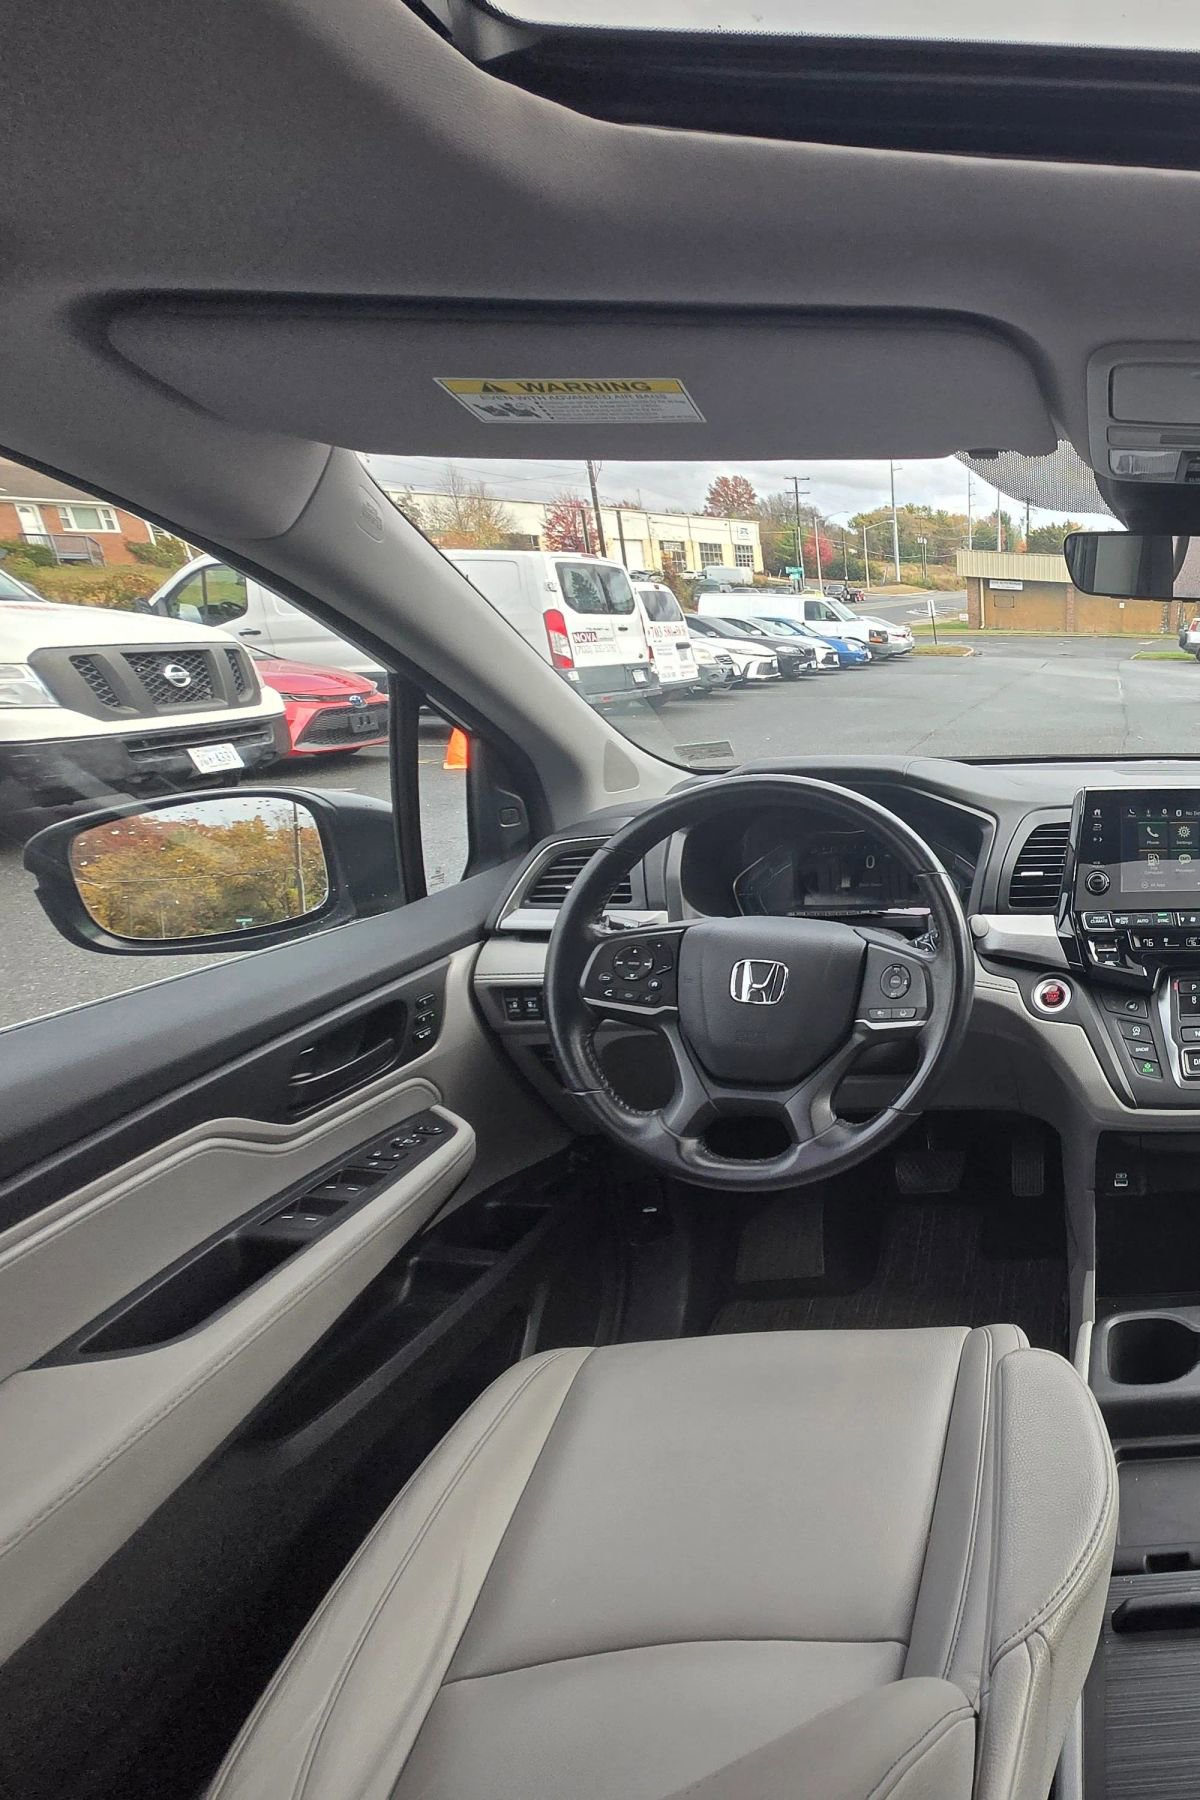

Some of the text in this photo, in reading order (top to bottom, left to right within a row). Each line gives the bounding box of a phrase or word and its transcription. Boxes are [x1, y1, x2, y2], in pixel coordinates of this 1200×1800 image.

[516, 381, 653, 393] WARNING
[573, 632, 598, 643] NOVA
[866, 855, 875, 869] 0
